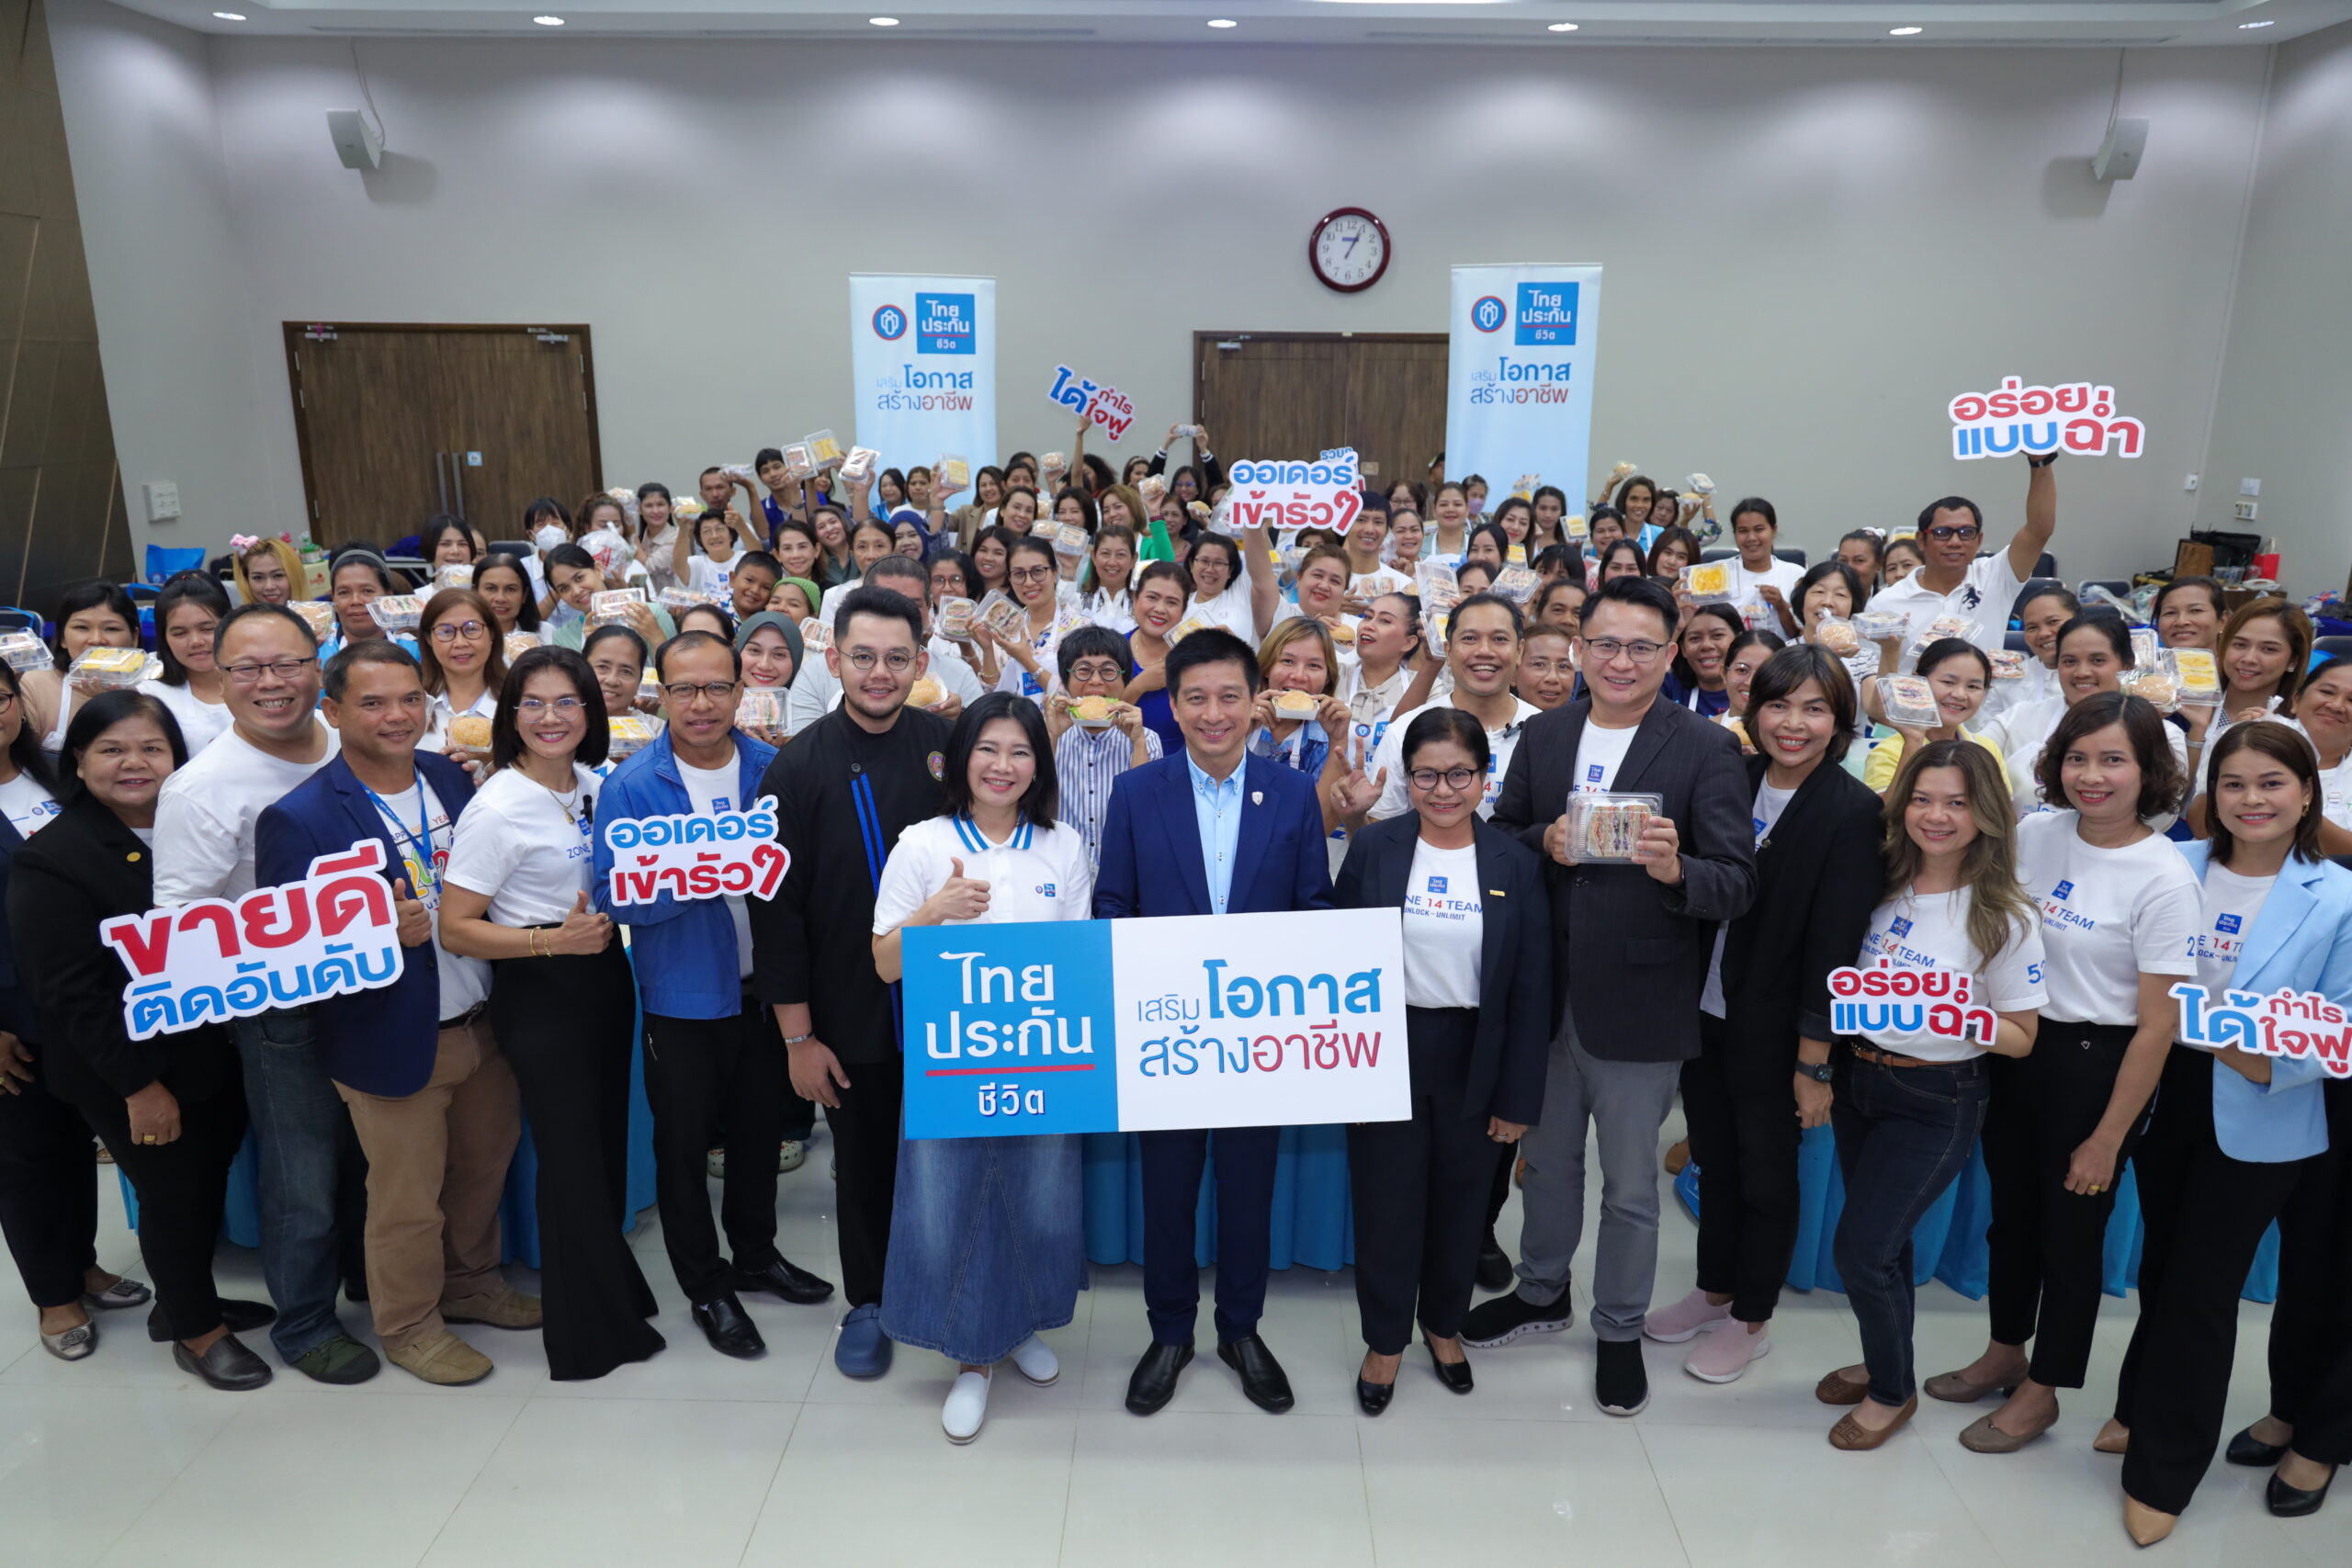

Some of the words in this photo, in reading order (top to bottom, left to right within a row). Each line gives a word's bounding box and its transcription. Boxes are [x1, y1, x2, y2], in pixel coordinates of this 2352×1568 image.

[1326, 231, 1335, 241] 10
[1335, 222, 1343, 232] 11
[1347, 220, 1358, 230] 12
[1323, 244, 1329, 254] 9
[1369, 234, 1375, 243] 2
[1325, 258, 1331, 266] 8
[1371, 246, 1377, 256] 3
[1333, 267, 1340, 276] 7
[1345, 271, 1351, 280] 6
[1358, 268, 1364, 277] 5
[1365, 260, 1372, 268] 4
[926, 299, 959, 318] ไทย
[1528, 289, 1562, 307] ไทย
[922, 318, 970, 333] ประกัน
[1521, 307, 1572, 323] ประกัน
[877, 389, 973, 411] สร้างอาชีพ
[1050, 367, 1097, 413] ได้
[1099, 388, 1133, 415] กำไร
[1470, 382, 1568, 404] สร้างอาชีพ
[1953, 379, 2088, 422] อร่อย
[1085, 398, 1133, 441] ใจฟู
[1233, 456, 1354, 485] ออเดอร์
[1233, 491, 1360, 532] เข้ารัวๆ
[610, 800, 774, 849] ออเดอร์
[615, 843, 786, 901] เข้ารัวๆ
[109, 844, 391, 976] ขายดี
[1405, 895, 1422, 906] NE
[1428, 897, 1443, 909] 14
[1446, 900, 1484, 914] TEAM
[1436, 911, 1466, 921] UNLIMIT
[2042, 901, 2058, 915] 14
[2057, 908, 2096, 931] TEAM
[1883, 938, 1900, 953] 14
[1898, 945, 1936, 967] TEAM
[2213, 937, 2231, 952] 14
[131, 942, 397, 1034] ติดอันดับ
[939, 951, 1055, 1004] ไทย
[1832, 959, 1951, 998] อร่อย
[2175, 987, 2260, 1049] ได้
[2268, 991, 2343, 1023] กำไร
[925, 1009, 1095, 1060] ประกัน
[2259, 1015, 2352, 1074] ใจฟู
[1139, 1019, 1383, 1077] สร้างอาชีพ
[978, 1082, 1046, 1117] ชีวิต
